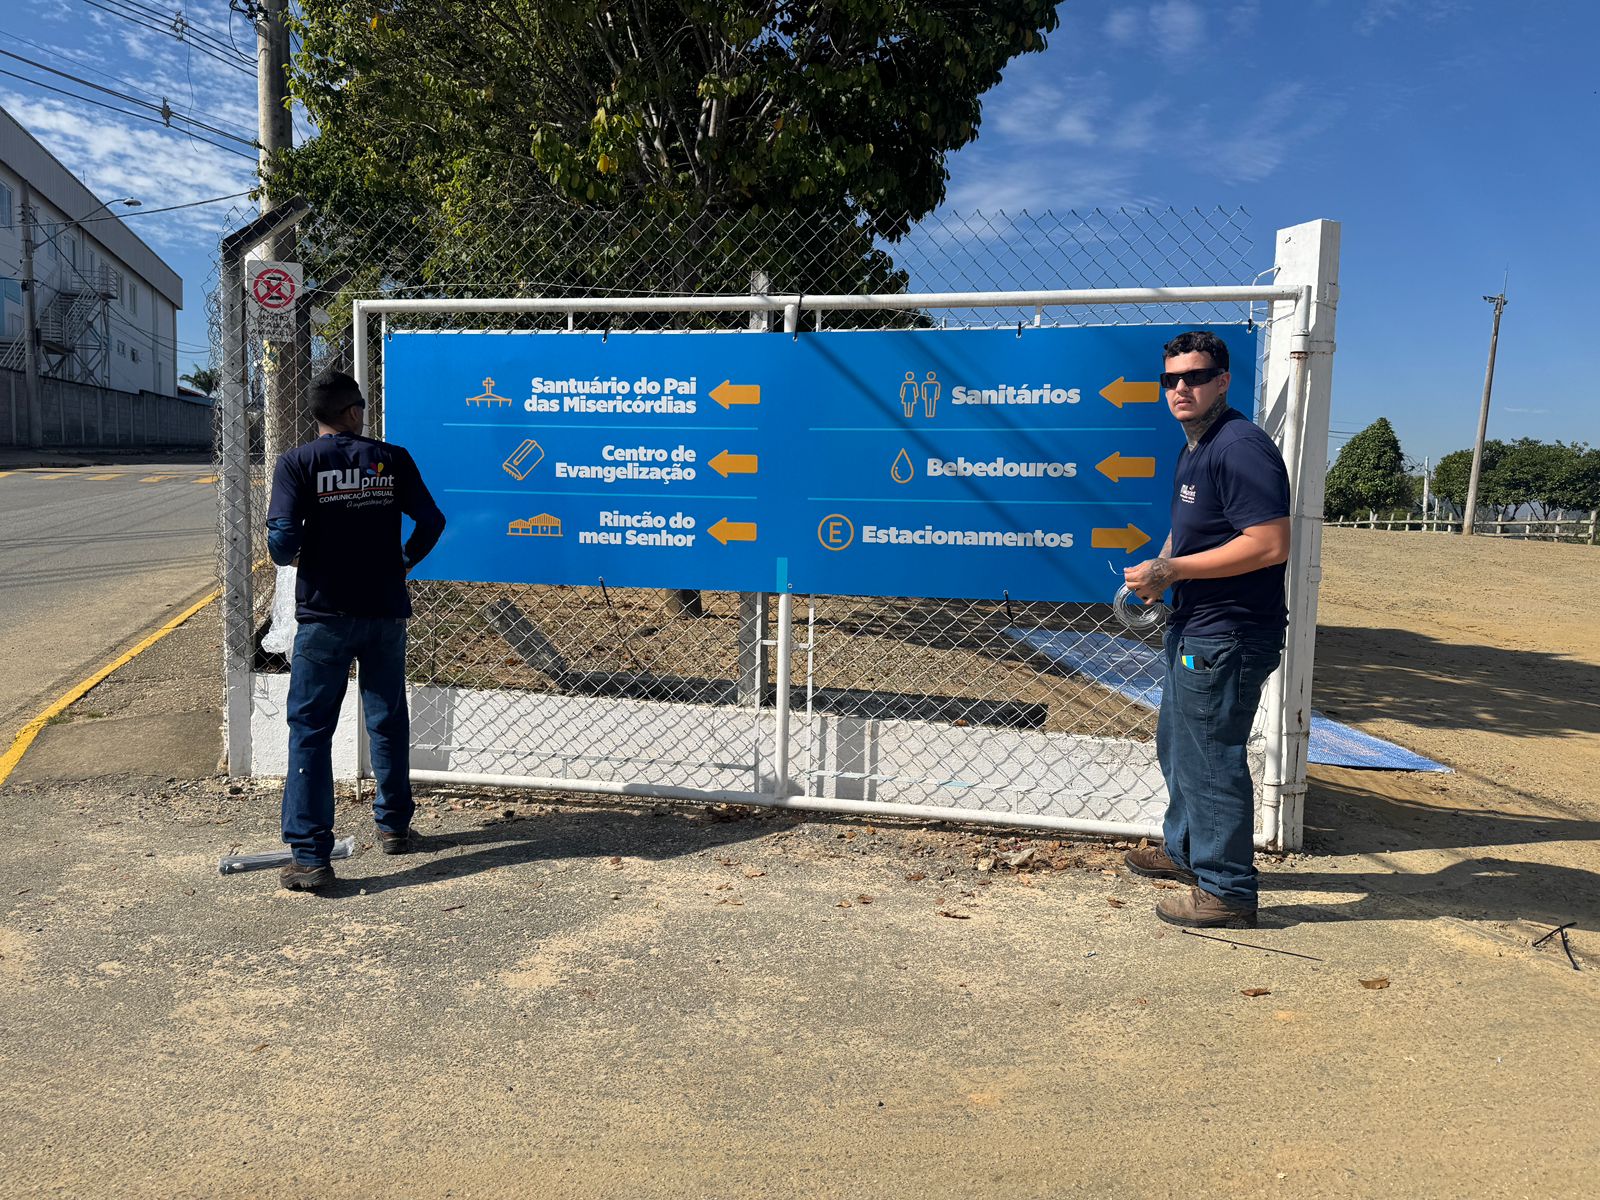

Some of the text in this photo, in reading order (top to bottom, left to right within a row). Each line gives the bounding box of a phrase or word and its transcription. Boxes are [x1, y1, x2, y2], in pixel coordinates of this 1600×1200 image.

[532, 376, 697, 396] Santuário do Pai
[952, 384, 1081, 405] Sanitários
[524, 395, 697, 414] das Misericórdias
[602, 445, 697, 463] Centro de
[556, 462, 697, 484] Evangelização
[927, 457, 1077, 477] Bebedouros
[319, 491, 371, 503] COMUNICAÇÃO
[600, 511, 696, 529] Rincão do
[579, 530, 696, 547] meu Senhor
[863, 525, 1074, 548] Estacionamentos
